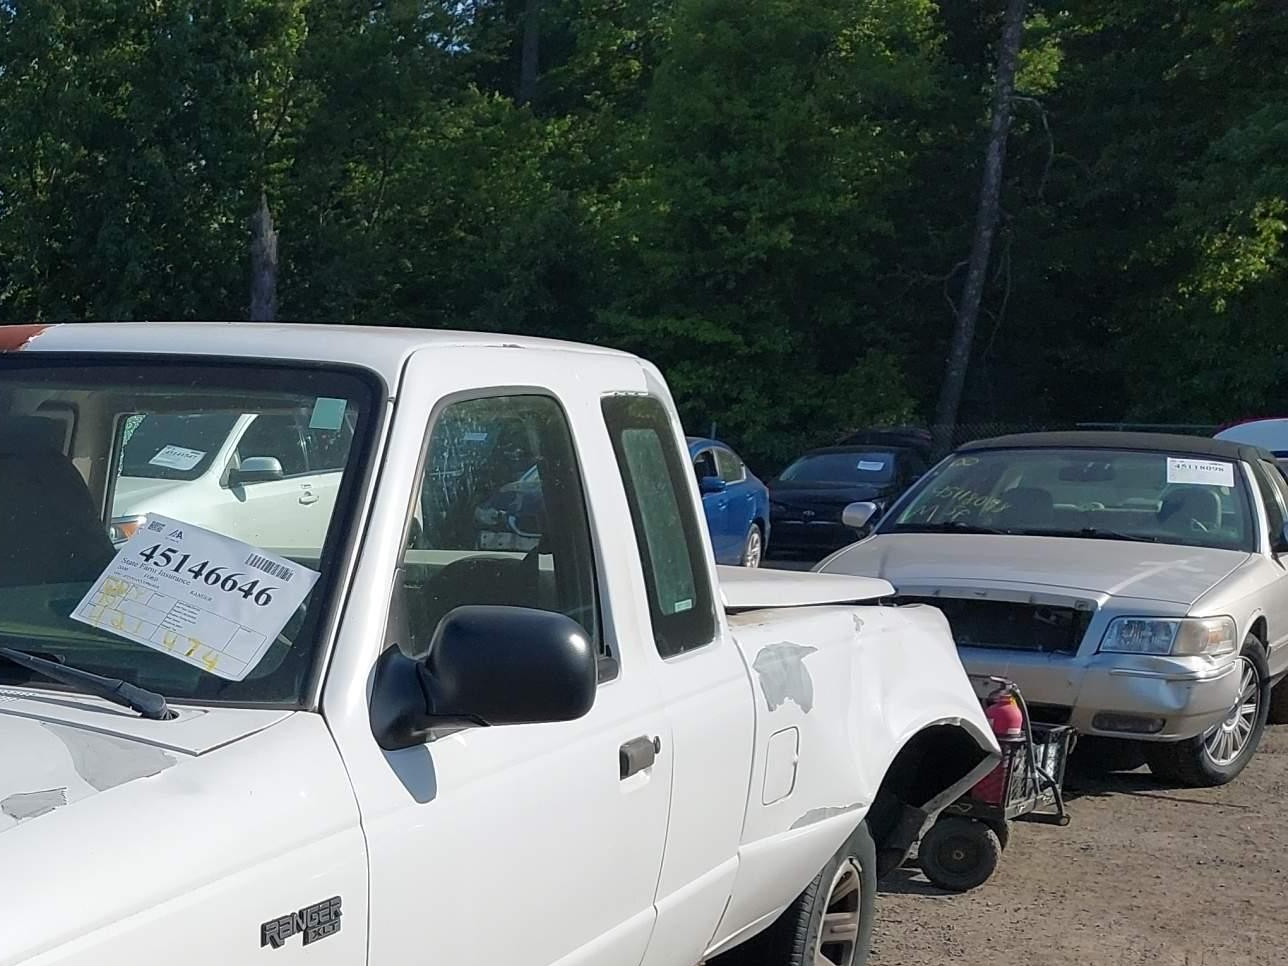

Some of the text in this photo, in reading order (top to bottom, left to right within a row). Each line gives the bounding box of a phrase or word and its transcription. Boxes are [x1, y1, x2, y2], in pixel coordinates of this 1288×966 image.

[122, 557, 138, 568] State
[139, 562, 157, 574] Farm
[158, 569, 191, 586] Insurance
[139, 543, 280, 607] 45146646
[261, 896, 342, 949] RANGER
[307, 920, 340, 942] XLT
